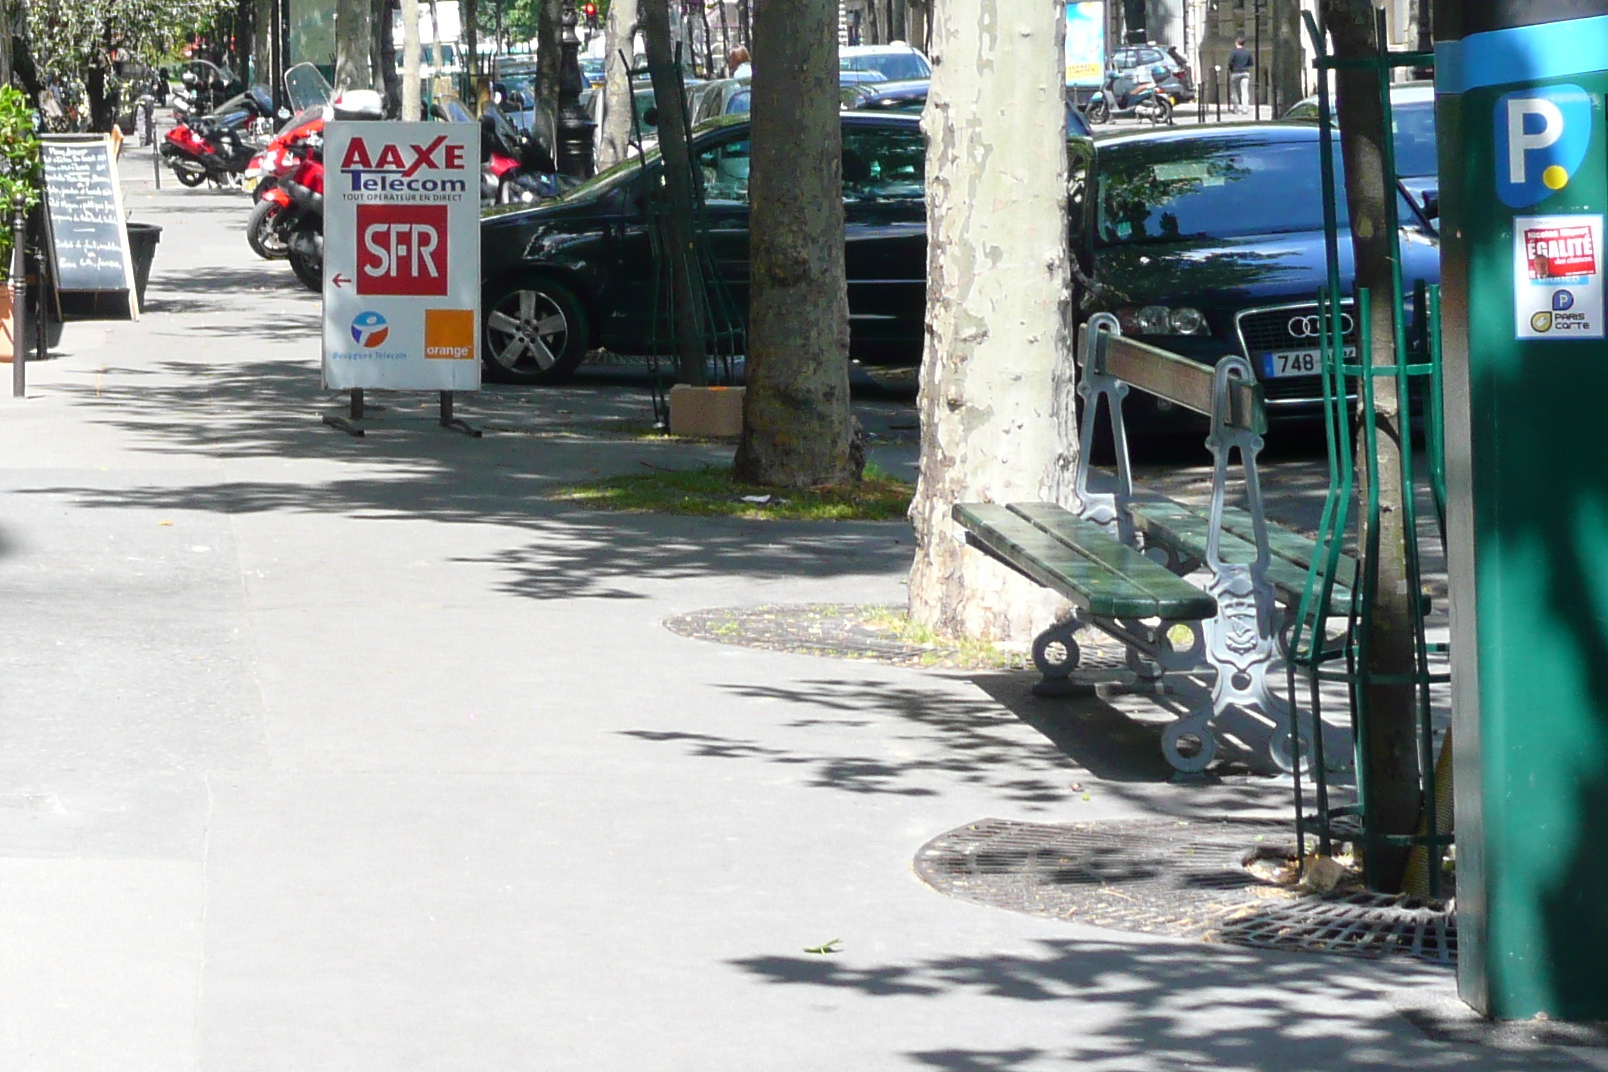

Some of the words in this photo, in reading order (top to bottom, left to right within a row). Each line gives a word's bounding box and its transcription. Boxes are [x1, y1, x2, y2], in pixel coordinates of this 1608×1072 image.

[1507, 97, 1564, 184] P
[340, 135, 465, 178] AAXE
[340, 169, 466, 192] Telecom
[342, 193, 364, 201] TOUT
[419, 193, 430, 201] EN
[433, 193, 462, 201] DIRECT
[363, 223, 439, 278] SFR
[426, 346, 469, 358] orange
[1277, 353, 1315, 374] 748
